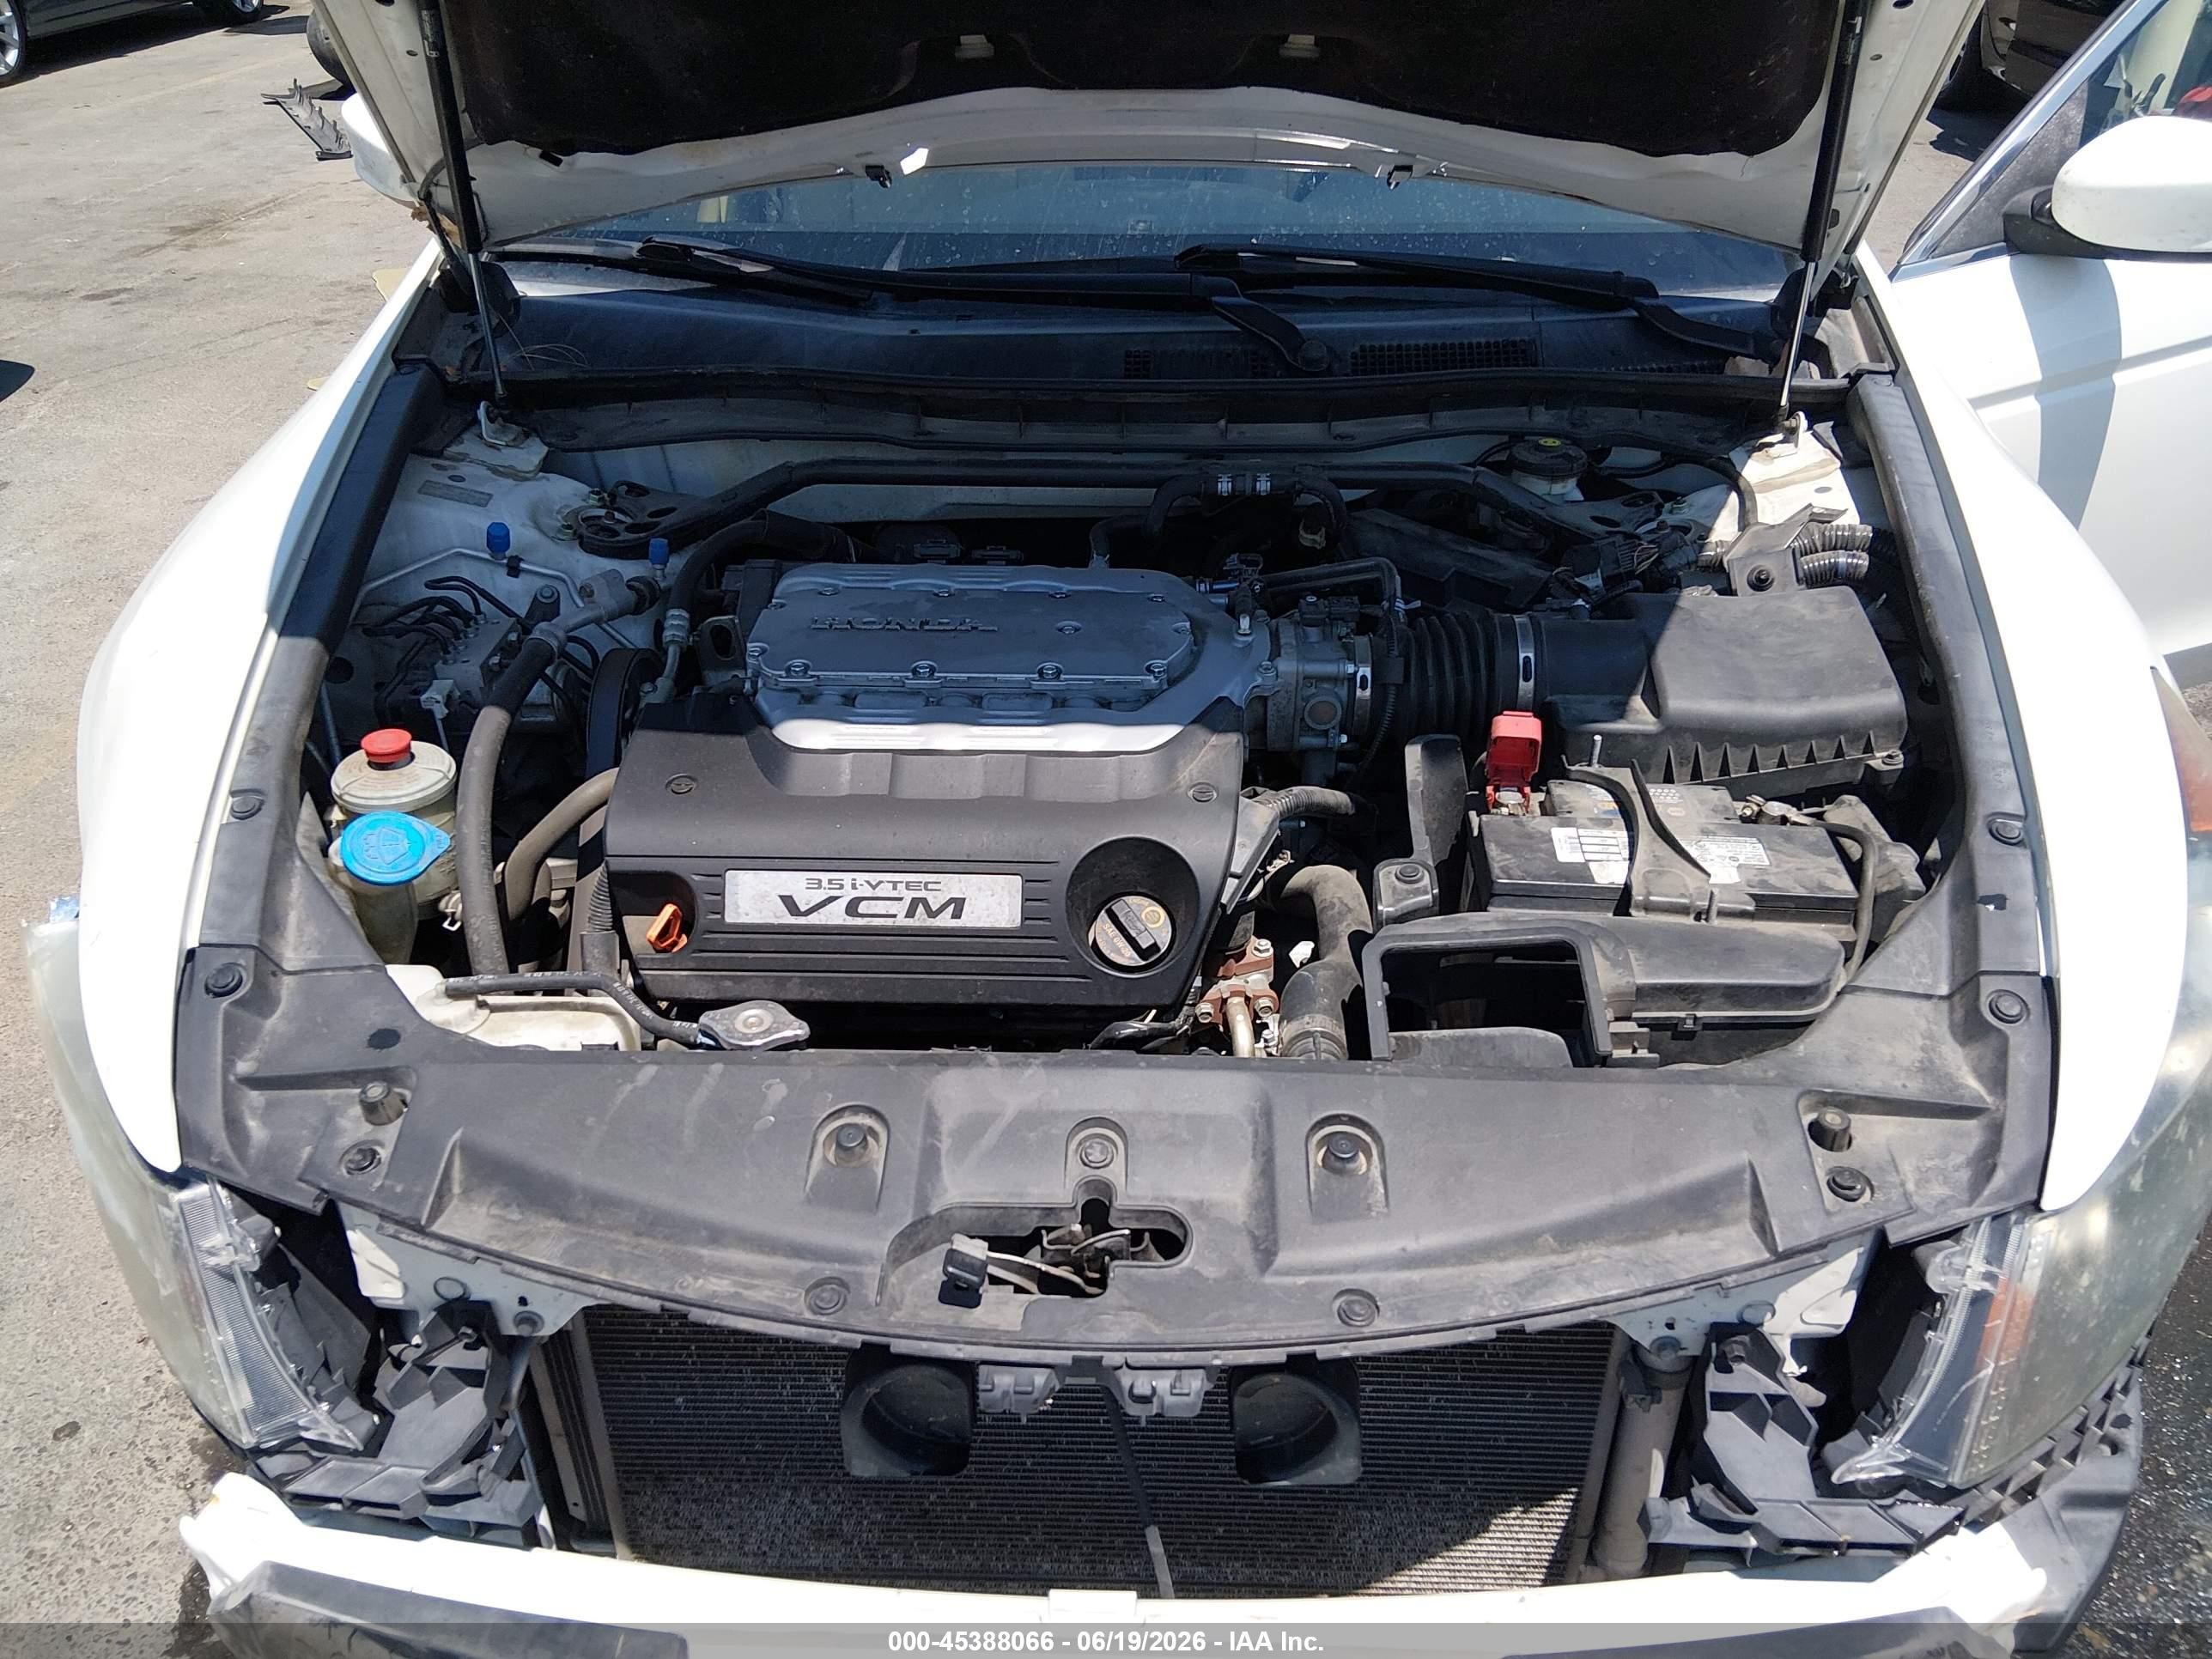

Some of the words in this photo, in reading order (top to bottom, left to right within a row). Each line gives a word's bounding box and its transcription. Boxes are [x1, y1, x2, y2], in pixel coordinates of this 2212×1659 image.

[810, 615, 998, 633] HONDA
[806, 878, 844, 890] 3.5
[851, 878, 942, 891] i-VTEC
[778, 895, 967, 920] VCM
[1103, 922, 1115, 939] SAE
